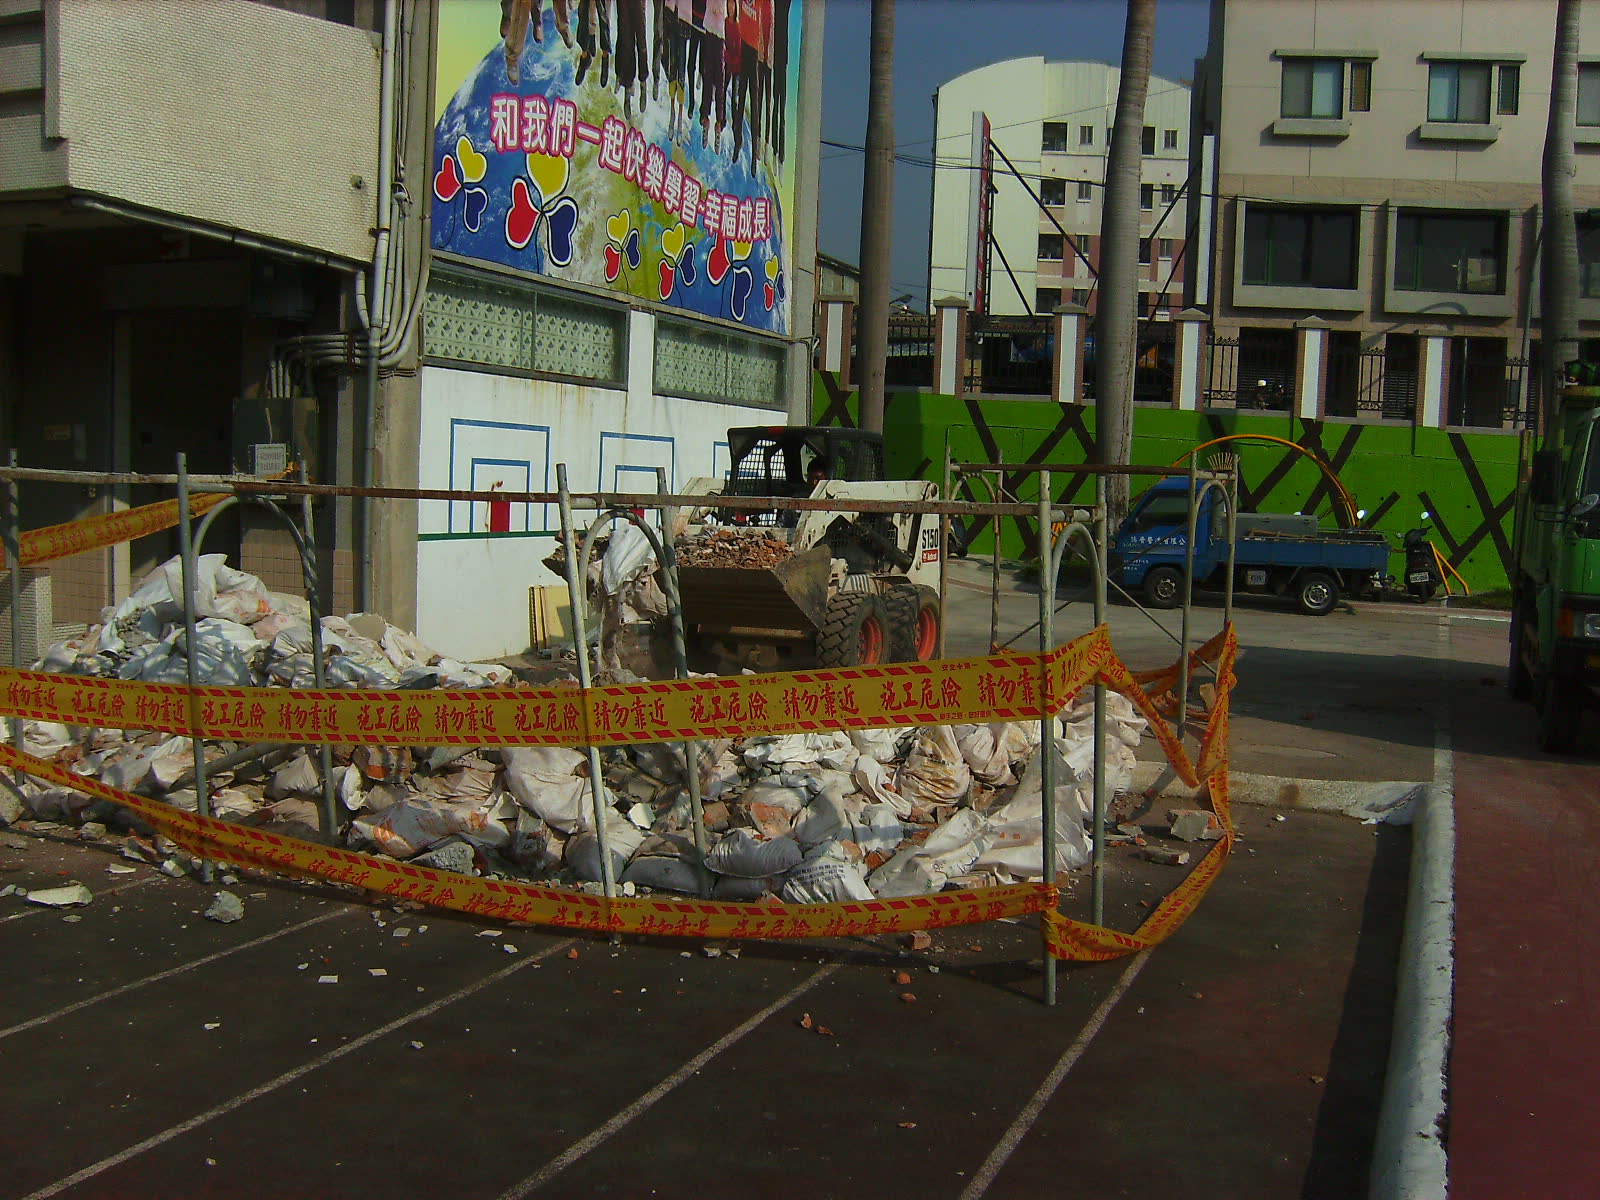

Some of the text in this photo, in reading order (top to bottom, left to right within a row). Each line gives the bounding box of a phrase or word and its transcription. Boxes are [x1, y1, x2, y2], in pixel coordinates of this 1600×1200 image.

[922, 528, 938, 550] S150
[6, 668, 1055, 734] 請勿靠近 施工危險 請勿靠近 施工危險 請勿靠近 施工危險 請勿靠近 施工危險 請勿靠近 施工危險 請勿靠近 施工危險 請勿靠近
